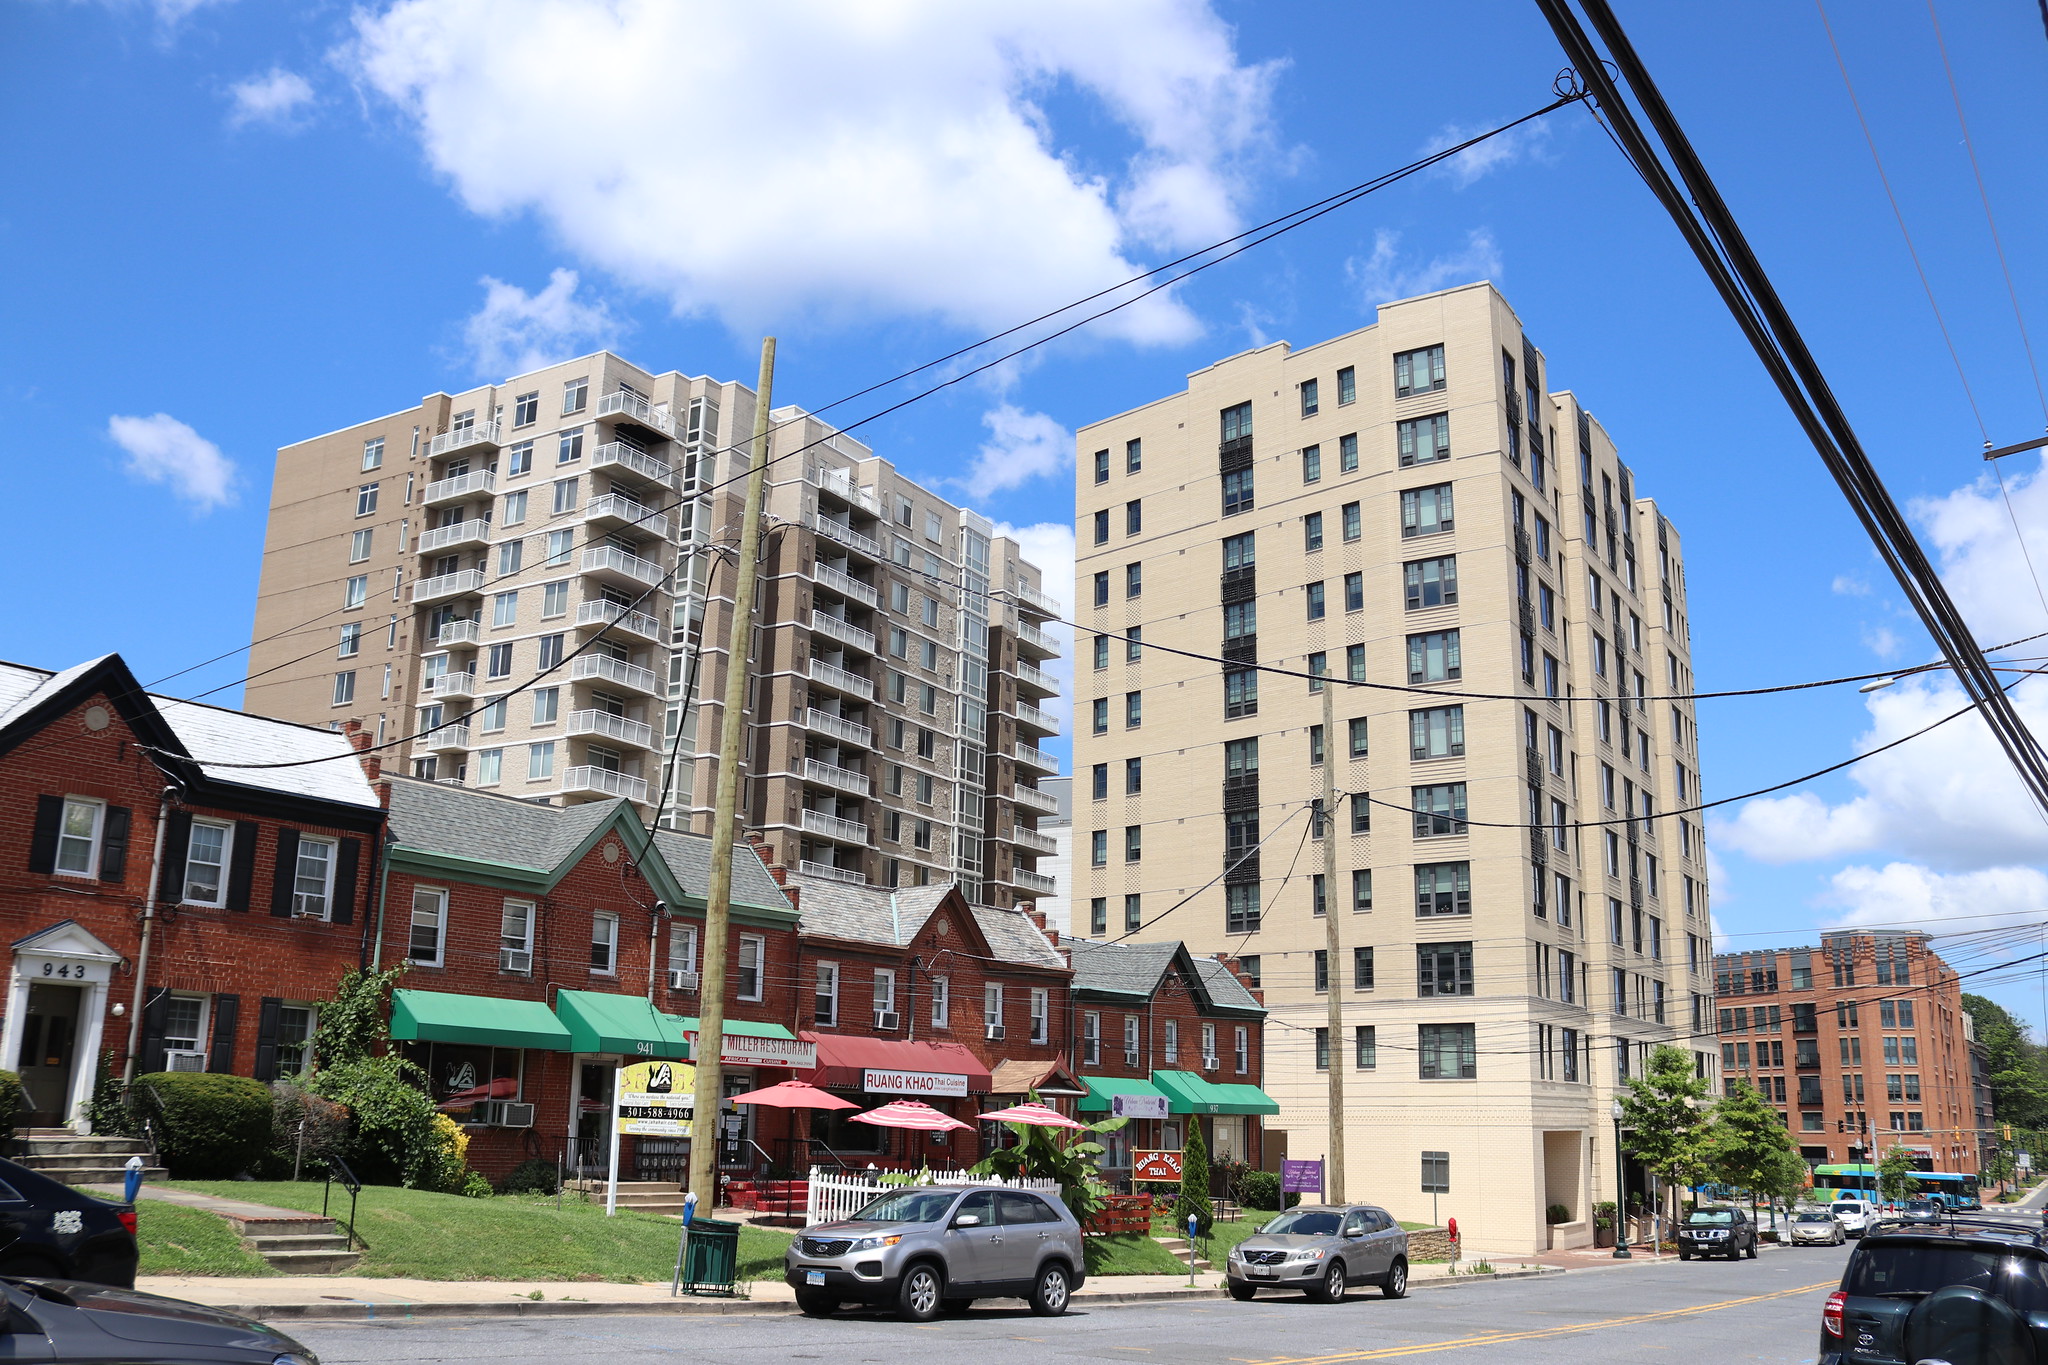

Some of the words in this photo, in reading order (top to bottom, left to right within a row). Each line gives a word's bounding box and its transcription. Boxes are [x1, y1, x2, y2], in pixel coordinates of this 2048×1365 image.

[43, 962, 85, 979] 943
[637, 1041, 654, 1055] 941
[727, 1035, 758, 1052] MILLER
[759, 1039, 814, 1057] RESTAURANT
[724, 1055, 747, 1063] AFRICAN
[866, 1073, 903, 1089] RUANG
[905, 1075, 934, 1091] KHAO
[934, 1077, 946, 1085] Thai
[946, 1078, 965, 1087] Cuisine
[627, 1107, 690, 1120] 301-588-4966
[1209, 1104, 1219, 1113] 937
[1135, 1153, 1159, 1171] RUANG
[1162, 1153, 1182, 1174] KHAO
[1148, 1167, 1167, 1176] THAI
